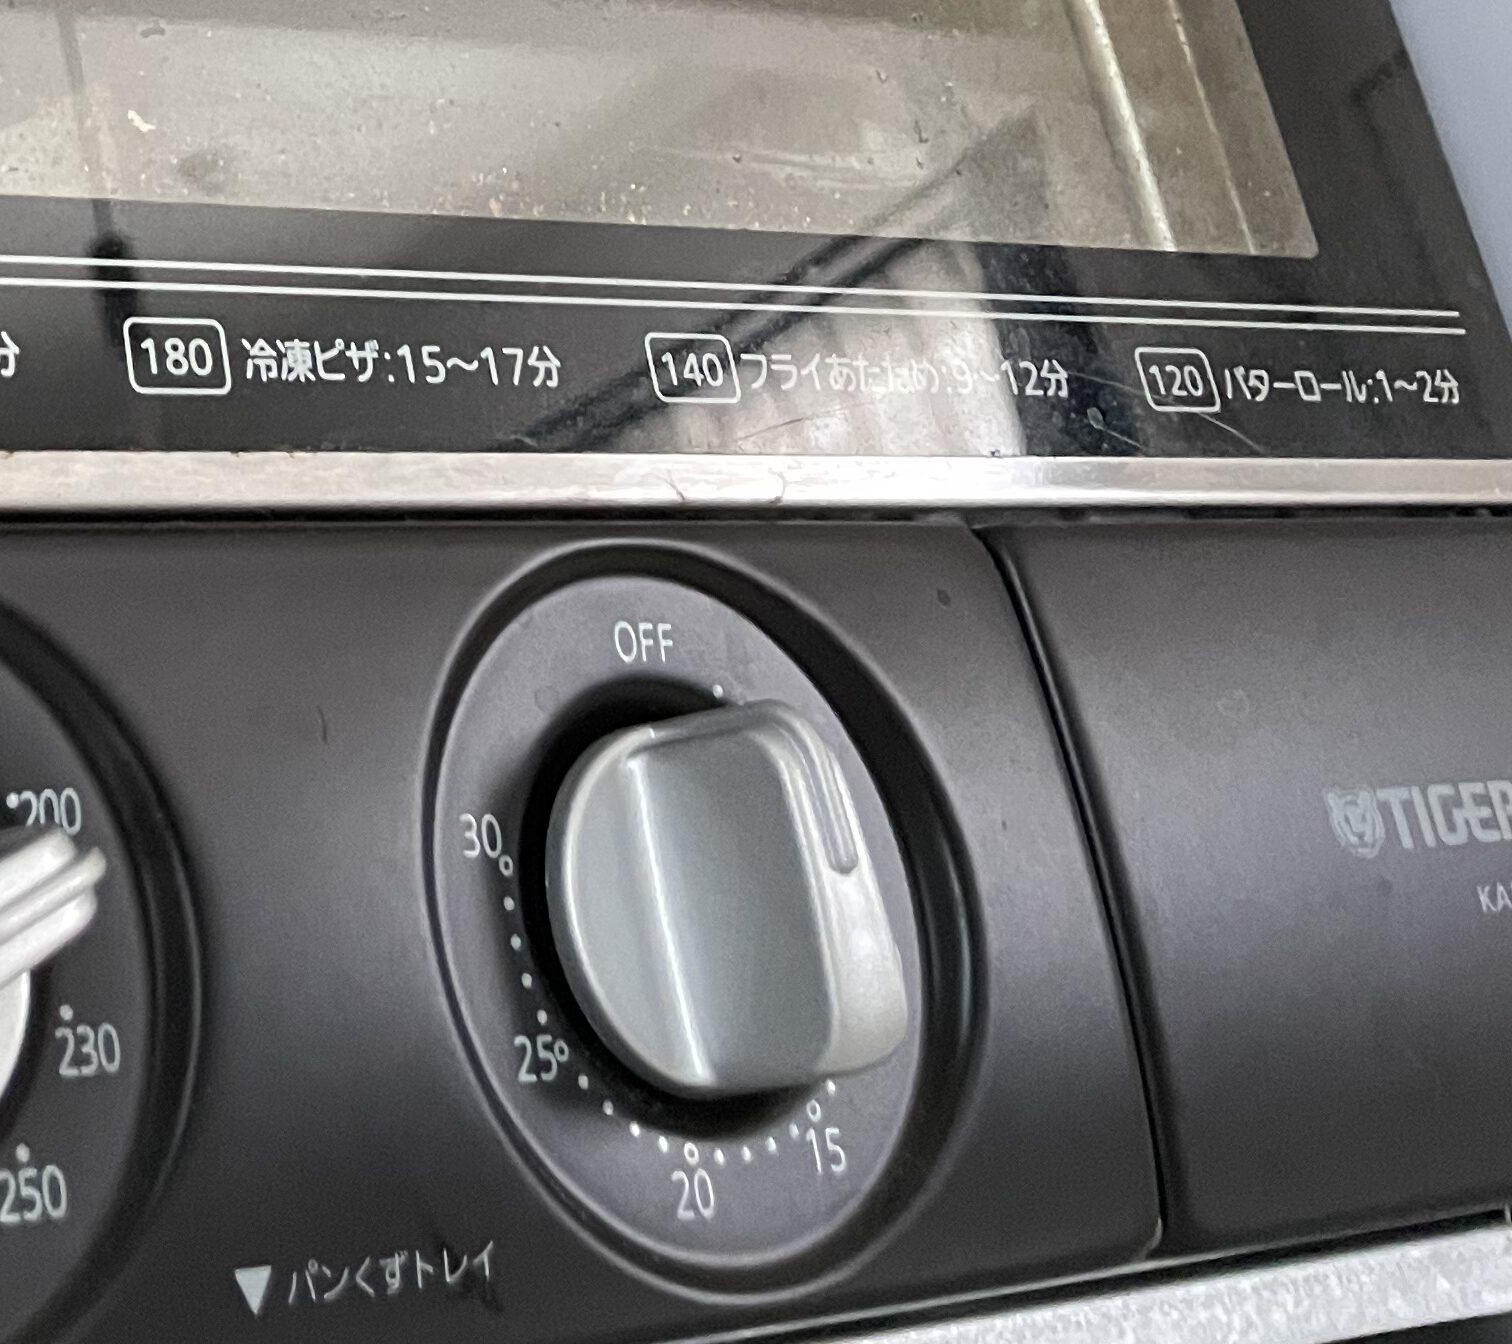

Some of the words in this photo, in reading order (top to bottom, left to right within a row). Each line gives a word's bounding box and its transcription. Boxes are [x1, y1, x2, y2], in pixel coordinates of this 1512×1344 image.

[138, 335, 214, 378] 180
[660, 351, 725, 388] 140
[1148, 364, 1204, 397] 120
[613, 620, 675, 665] OFF
[19, 787, 82, 837] 200
[459, 812, 502, 861] 30
[1376, 779, 1512, 849] TIGER
[1476, 881, 1512, 913] KA
[54, 1023, 121, 1077] 230
[805, 1125, 848, 1176] 15
[670, 1168, 716, 1220] 20
[288, 1240, 494, 1304] パンくずトレイ
